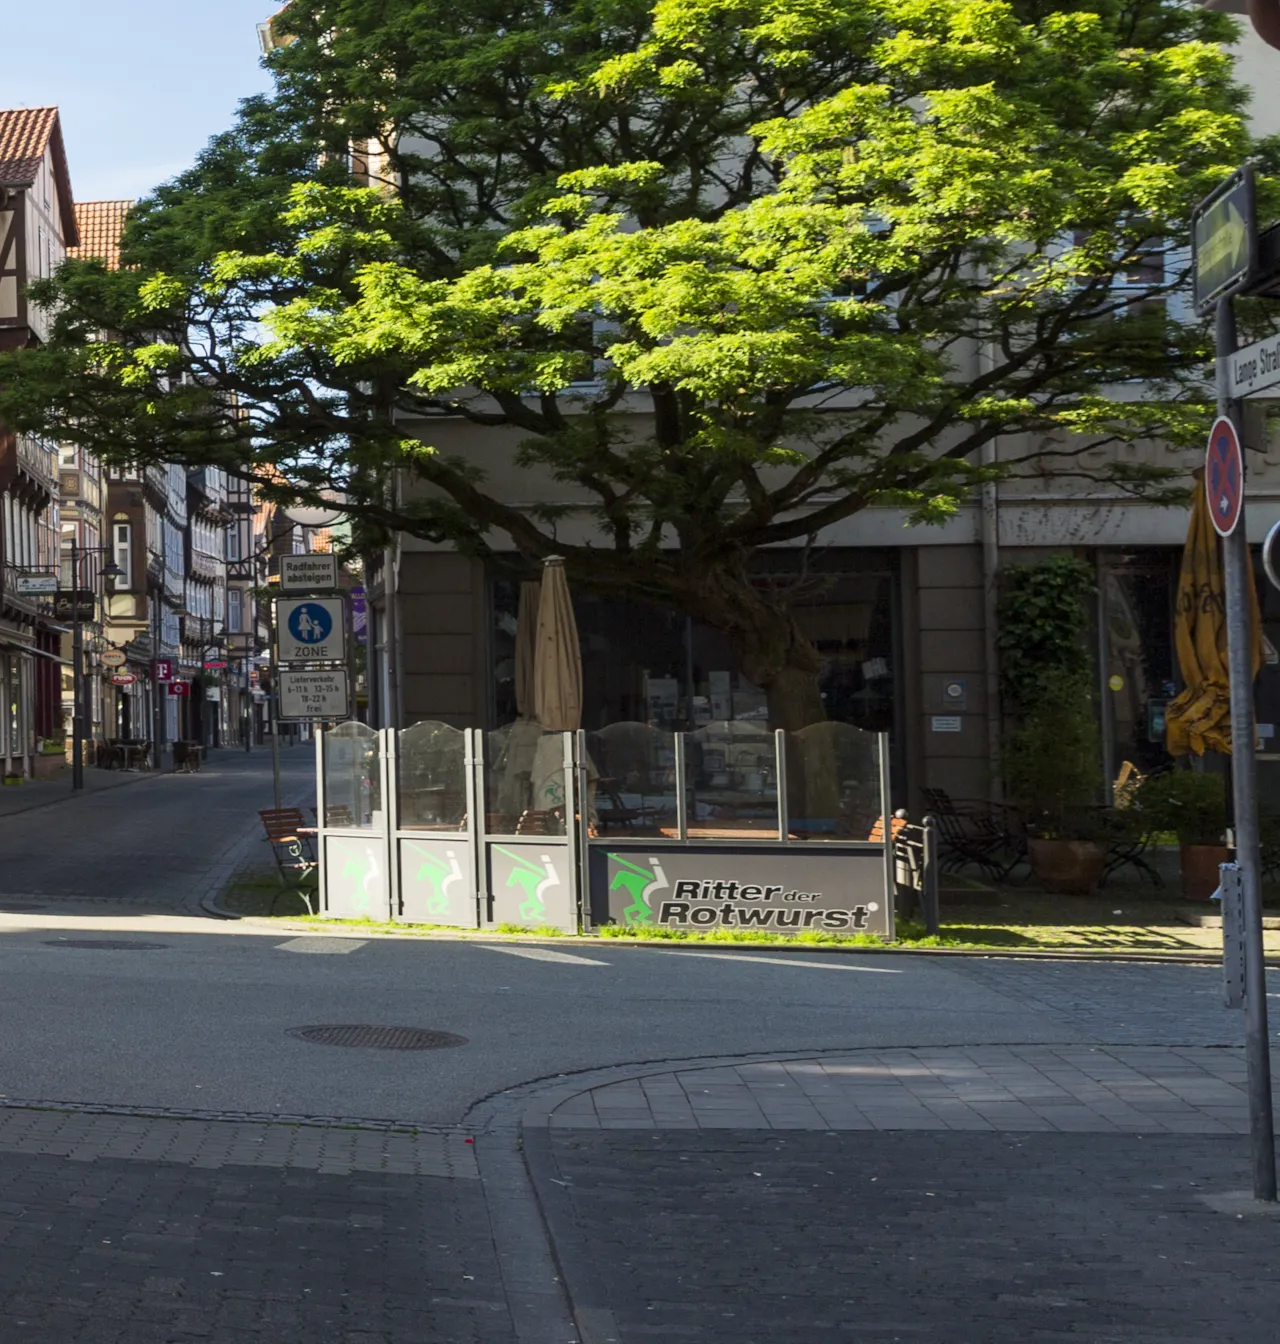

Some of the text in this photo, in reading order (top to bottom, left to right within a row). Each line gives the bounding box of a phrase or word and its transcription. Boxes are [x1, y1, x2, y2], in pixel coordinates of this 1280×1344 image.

[1234, 359, 1257, 387] Lange
[286, 562, 331, 571] Radfahrer
[287, 574, 332, 584] absteigen
[295, 646, 328, 657] ZONE
[290, 675, 335, 683] Lieferverkehr
[673, 880, 822, 903] Ritter der
[658, 901, 869, 929] Rotwurst
